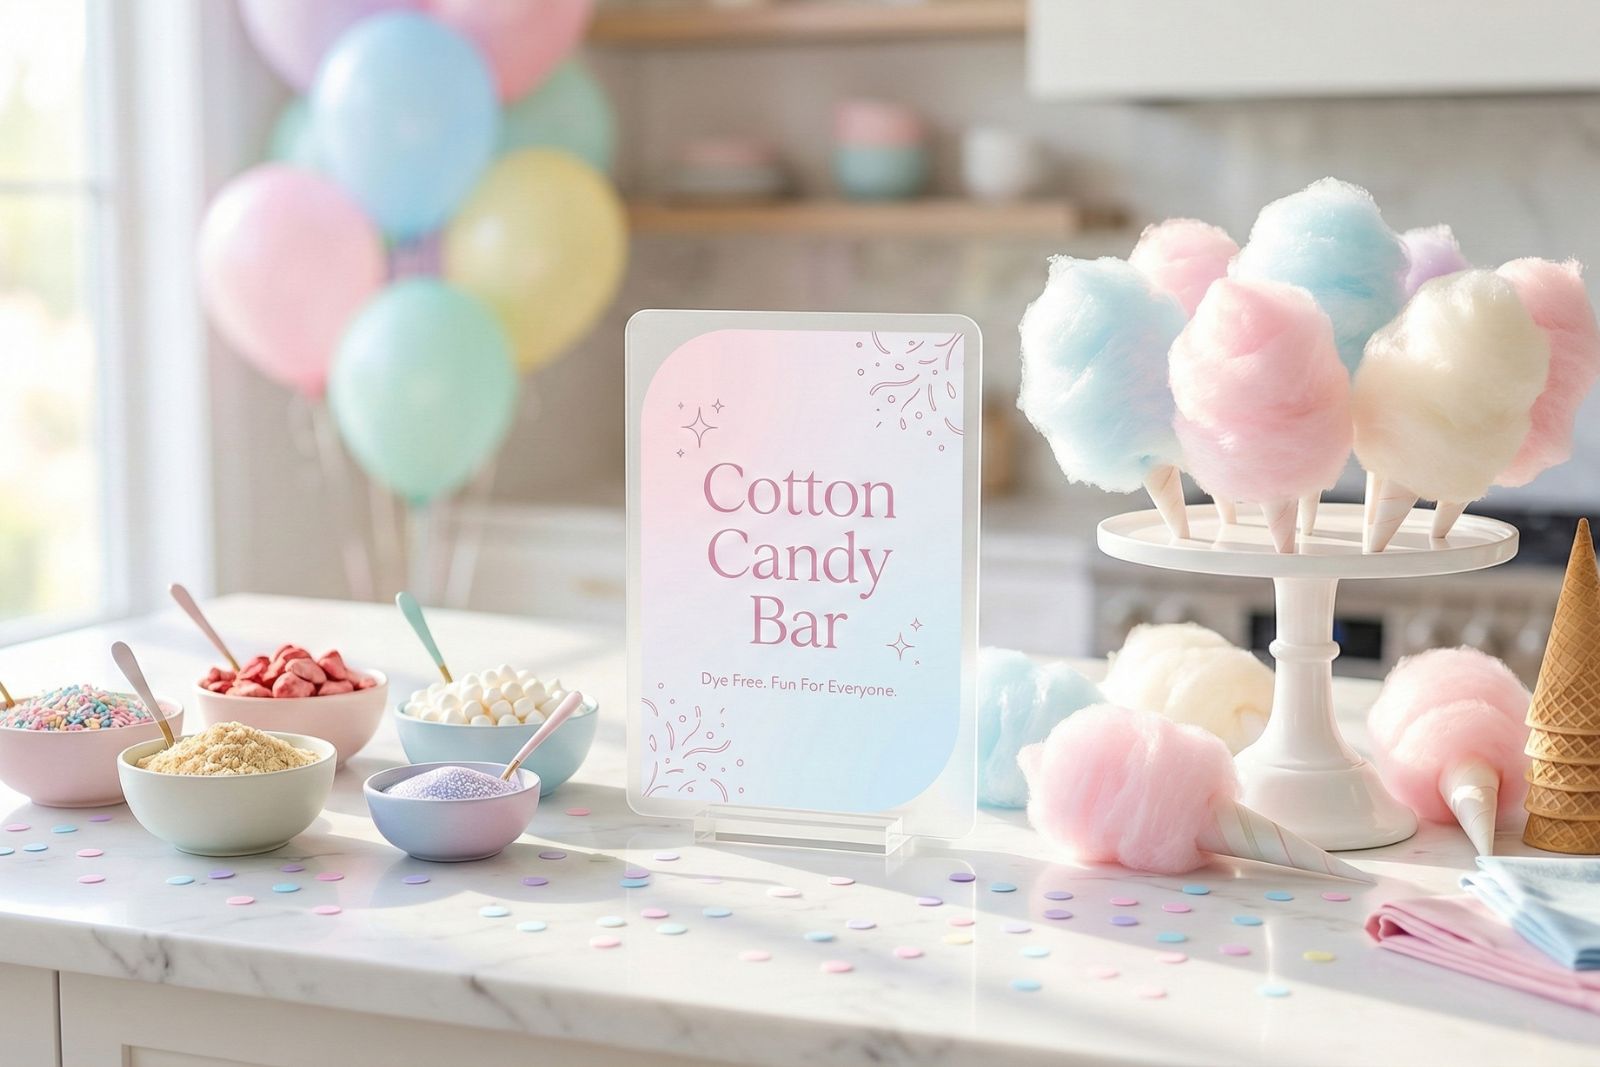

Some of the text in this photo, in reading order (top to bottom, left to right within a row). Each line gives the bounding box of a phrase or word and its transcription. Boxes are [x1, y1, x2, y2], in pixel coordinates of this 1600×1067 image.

[703, 462, 897, 519] Cotton
[707, 528, 894, 600] Candy
[749, 594, 849, 649] Bar
[701, 671, 898, 699] Dye Free. Fun For Everyone.
